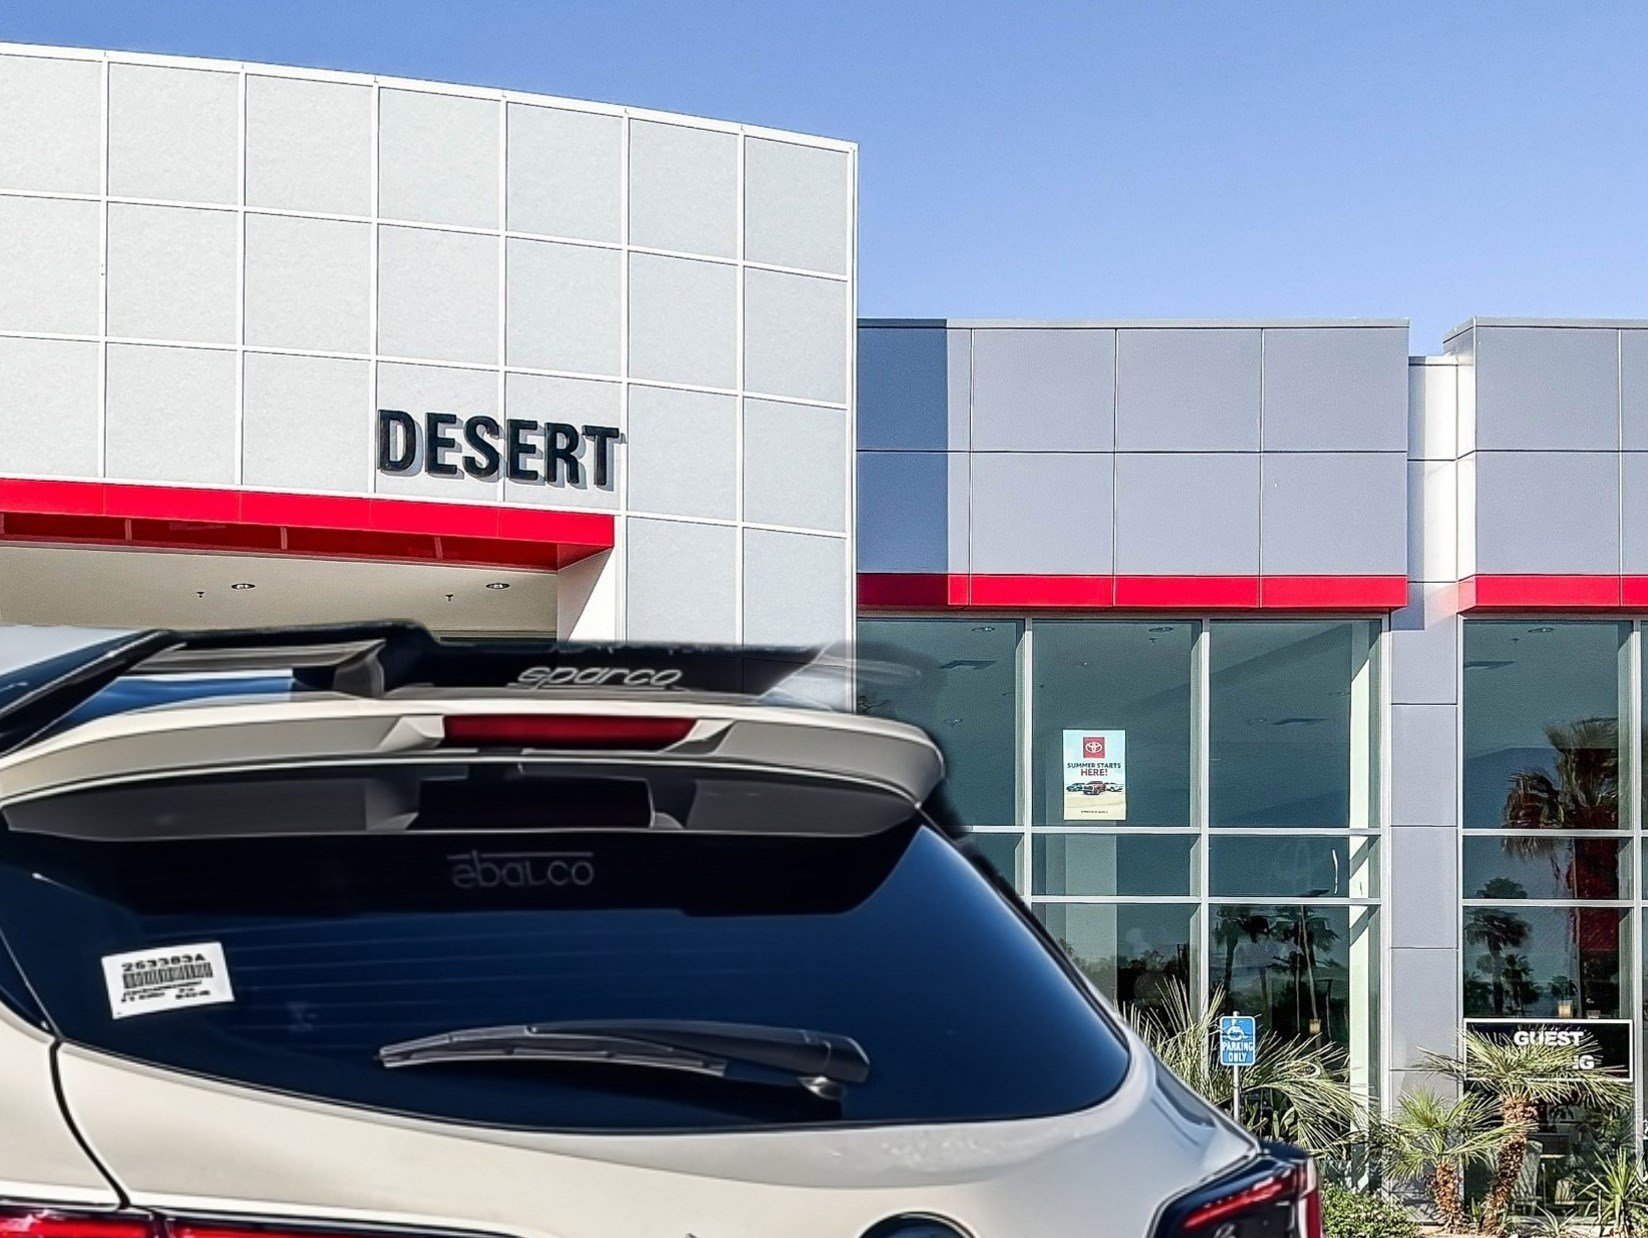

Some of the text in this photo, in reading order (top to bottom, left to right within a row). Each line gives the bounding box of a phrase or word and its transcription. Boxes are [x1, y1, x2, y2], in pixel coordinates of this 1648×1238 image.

[377, 409, 621, 487] DESERT
[517, 666, 683, 690] sparco
[1222, 1041, 1253, 1052] PARKING
[1514, 1030, 1584, 1047] GUEST
[1228, 1052, 1247, 1063] ONLY
